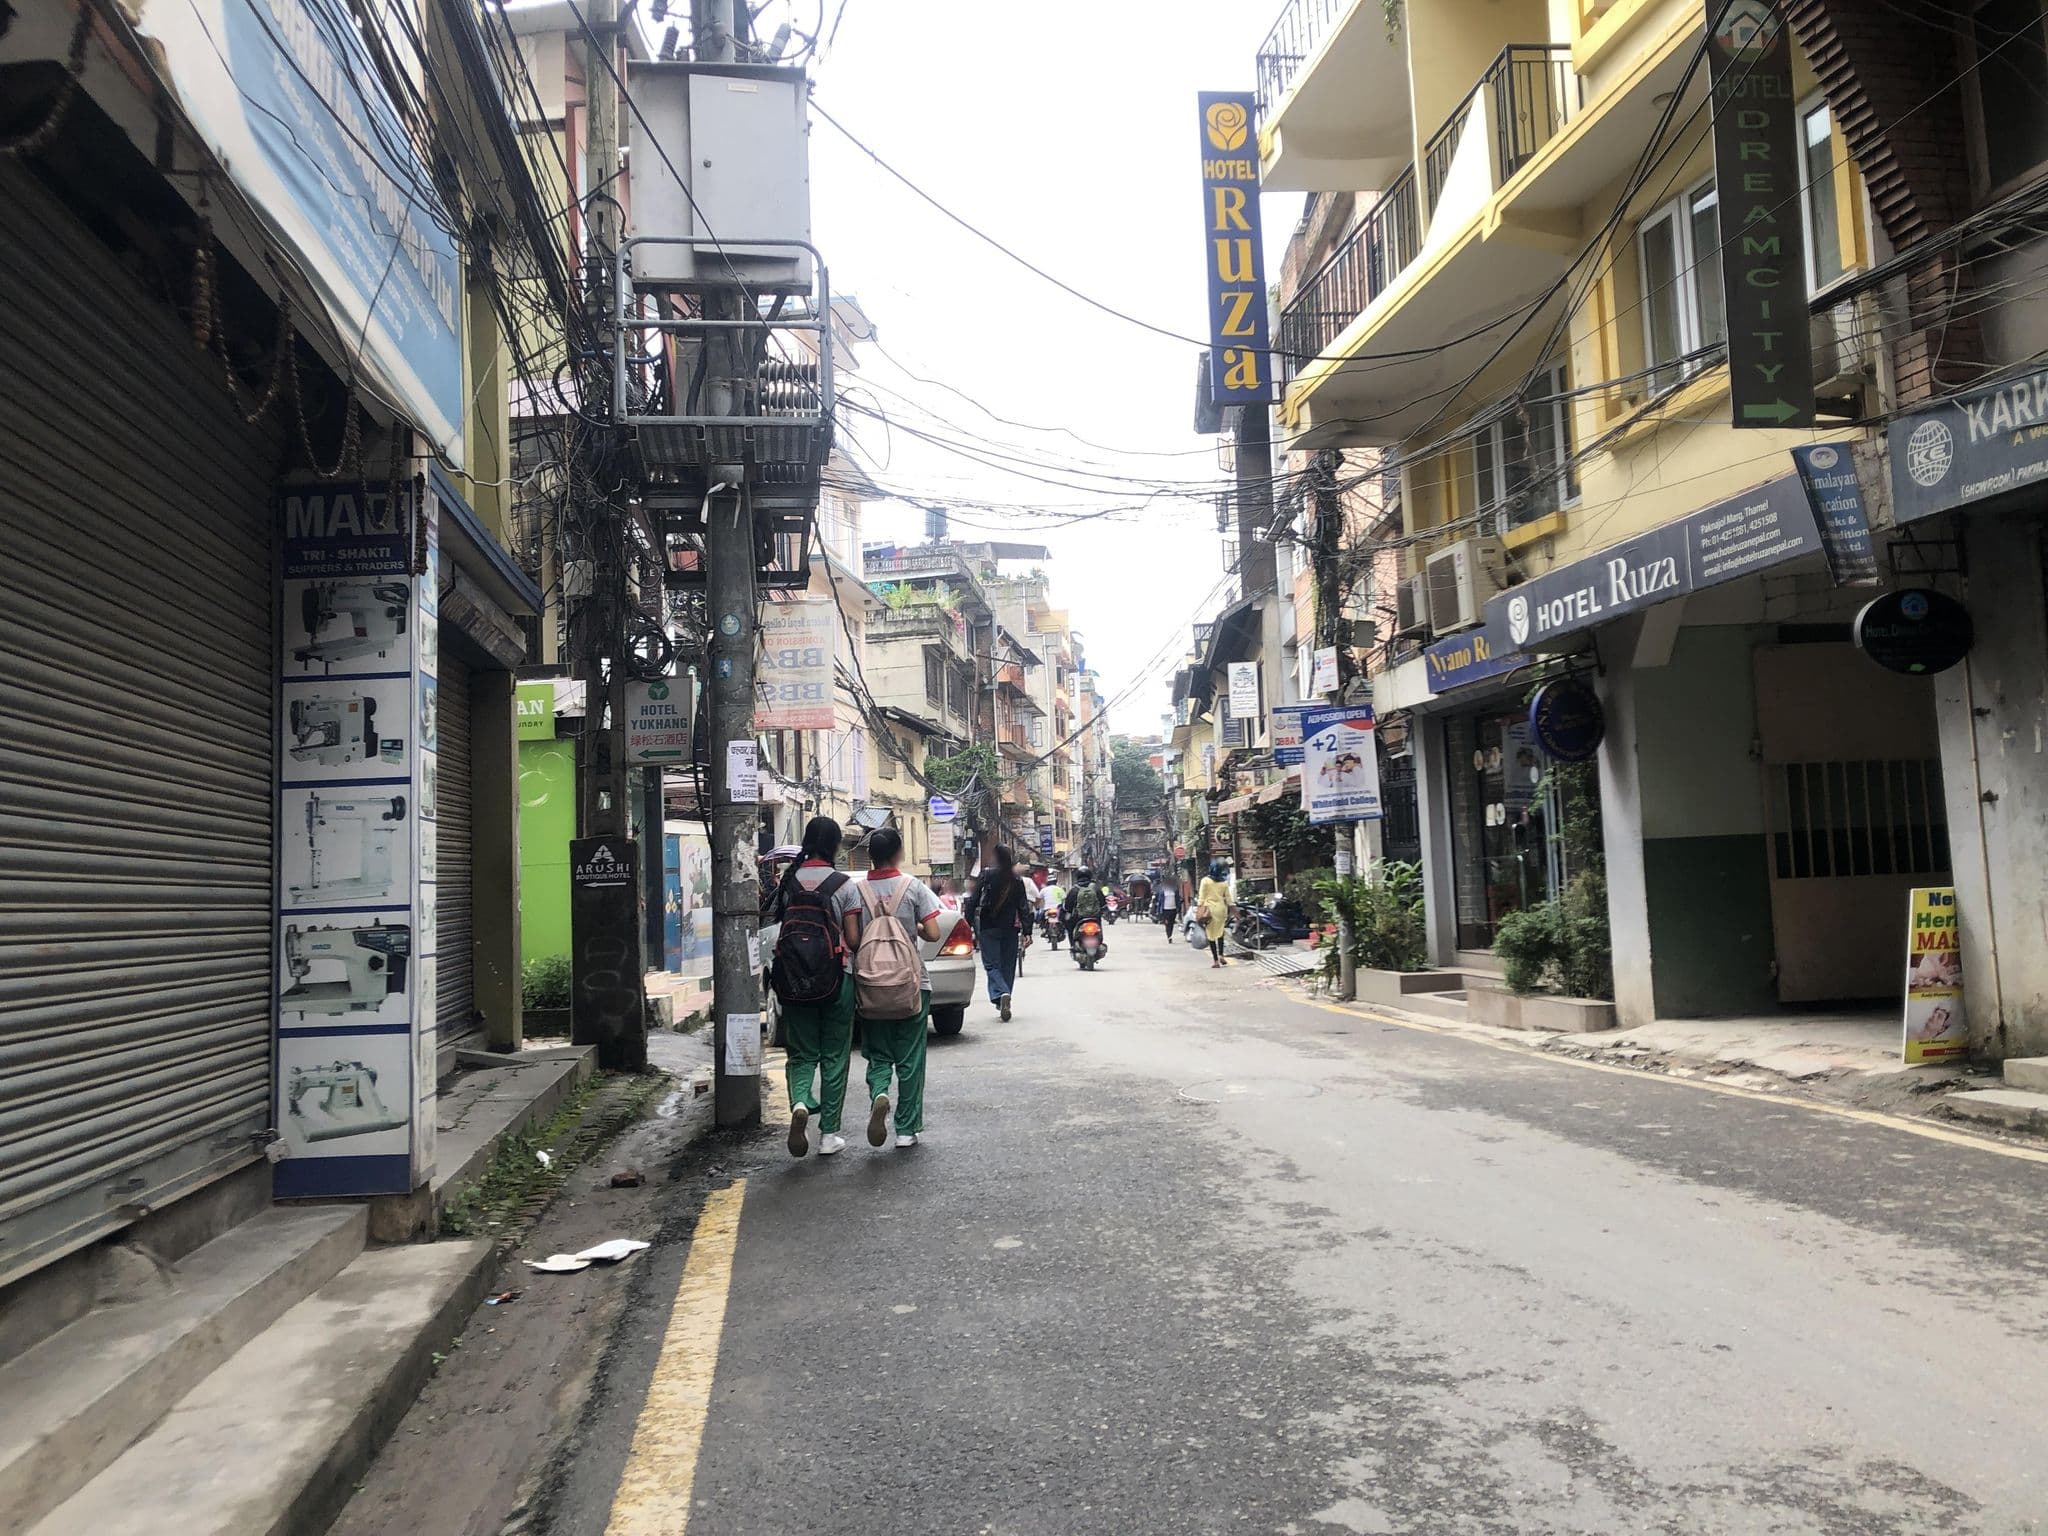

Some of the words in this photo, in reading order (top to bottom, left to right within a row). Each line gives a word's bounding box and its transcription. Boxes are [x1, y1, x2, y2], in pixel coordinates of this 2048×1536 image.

[1716, 73, 1790, 99] HOTEL
[1203, 158, 1256, 181] HOTEL
[2013, 431, 2025, 448] A
[1913, 443, 1947, 467] KE
[1744, 499, 1769, 517] Thamel
[1848, 514, 1857, 525] &
[302, 550, 326, 561] TRI
[337, 547, 392, 560] SHAKTI
[344, 563, 353, 571] &
[355, 560, 405, 571] TRADERS
[1536, 585, 1602, 633] HOTEL
[1606, 555, 1681, 608] Ruza
[640, 704, 678, 716] HOTEL
[1307, 711, 1346, 725] ADMISSION
[1346, 709, 1366, 720] OPEN
[631, 718, 688, 731] YUKHANG
[630, 733, 688, 747] 绿松石酒店
[1312, 733, 1338, 752] +2
[1312, 797, 1349, 809] Whitefield
[576, 863, 630, 874] ARUSHI
[608, 872, 632, 880] HOTEL
